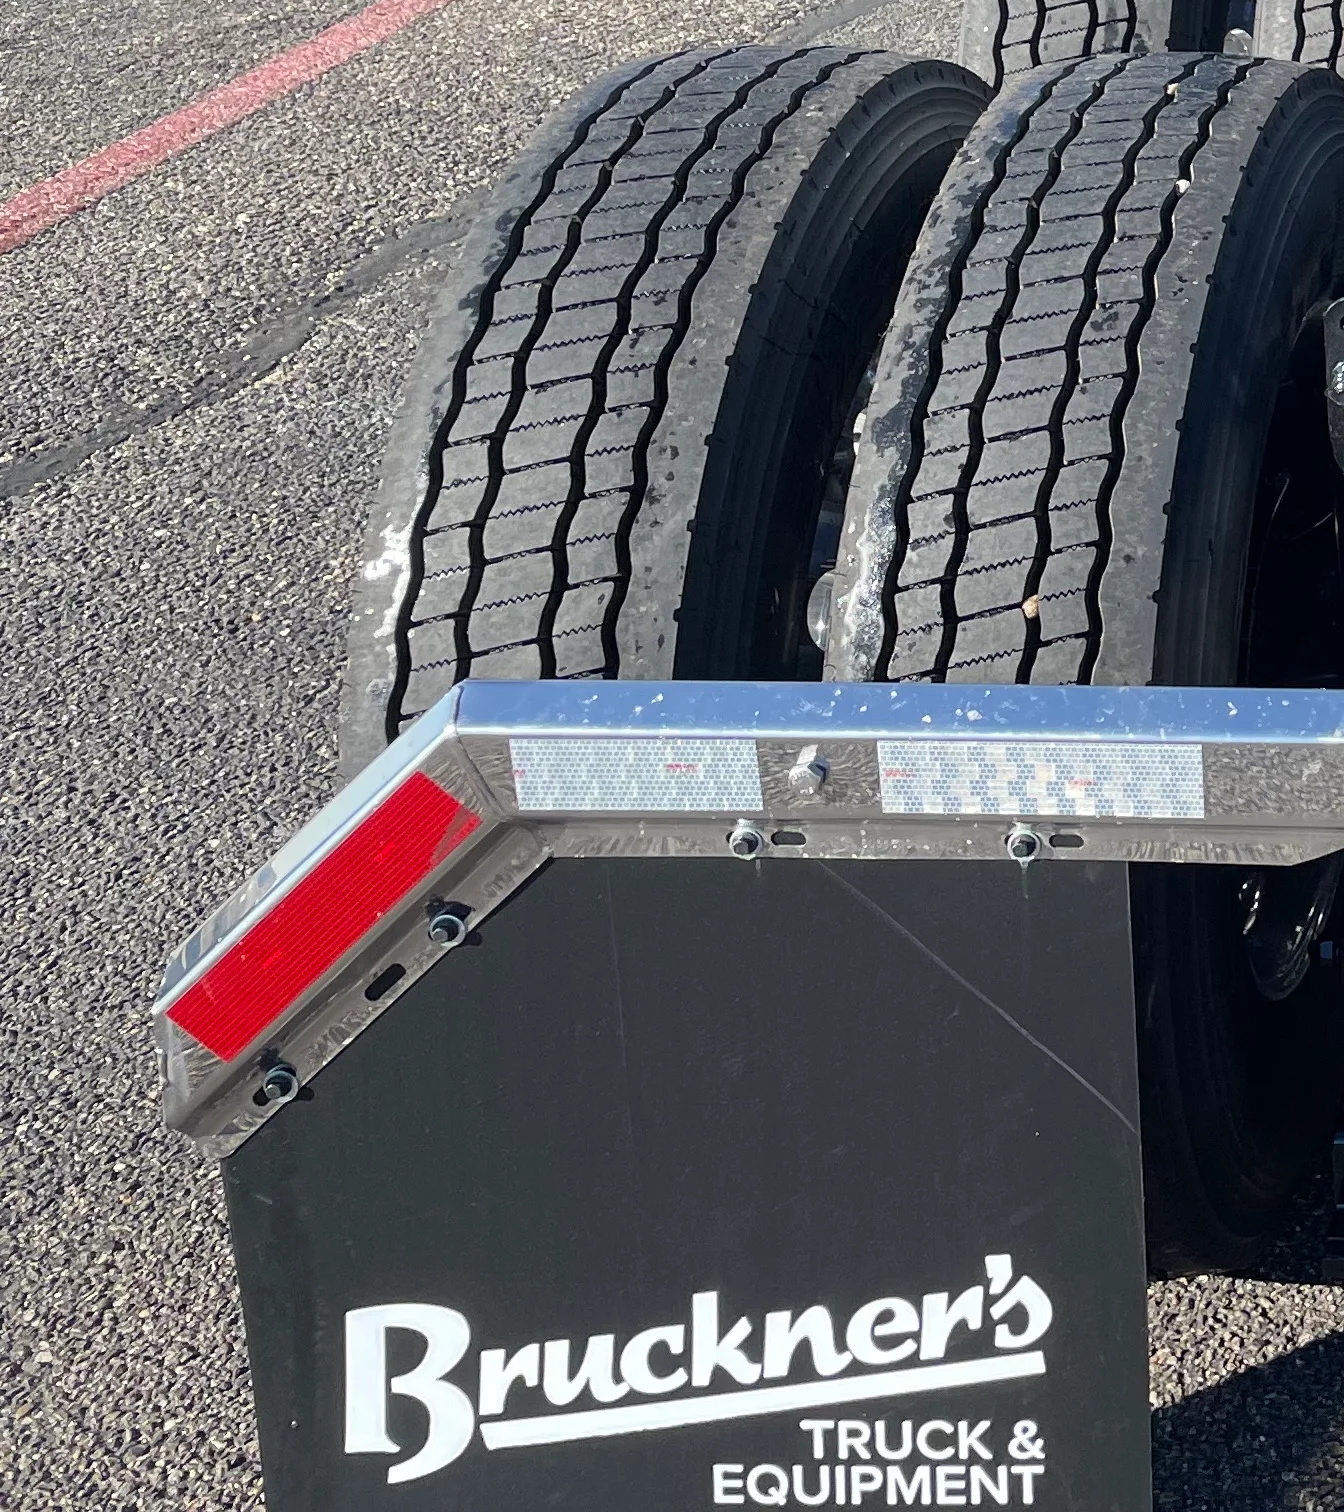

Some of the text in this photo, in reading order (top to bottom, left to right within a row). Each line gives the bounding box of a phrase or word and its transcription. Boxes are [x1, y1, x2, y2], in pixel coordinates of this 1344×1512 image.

[343, 1252, 1054, 1485] Bruckner's
[799, 1418, 1047, 1461] TRUCK &
[711, 1462, 1046, 1507] EQUIPMENT
